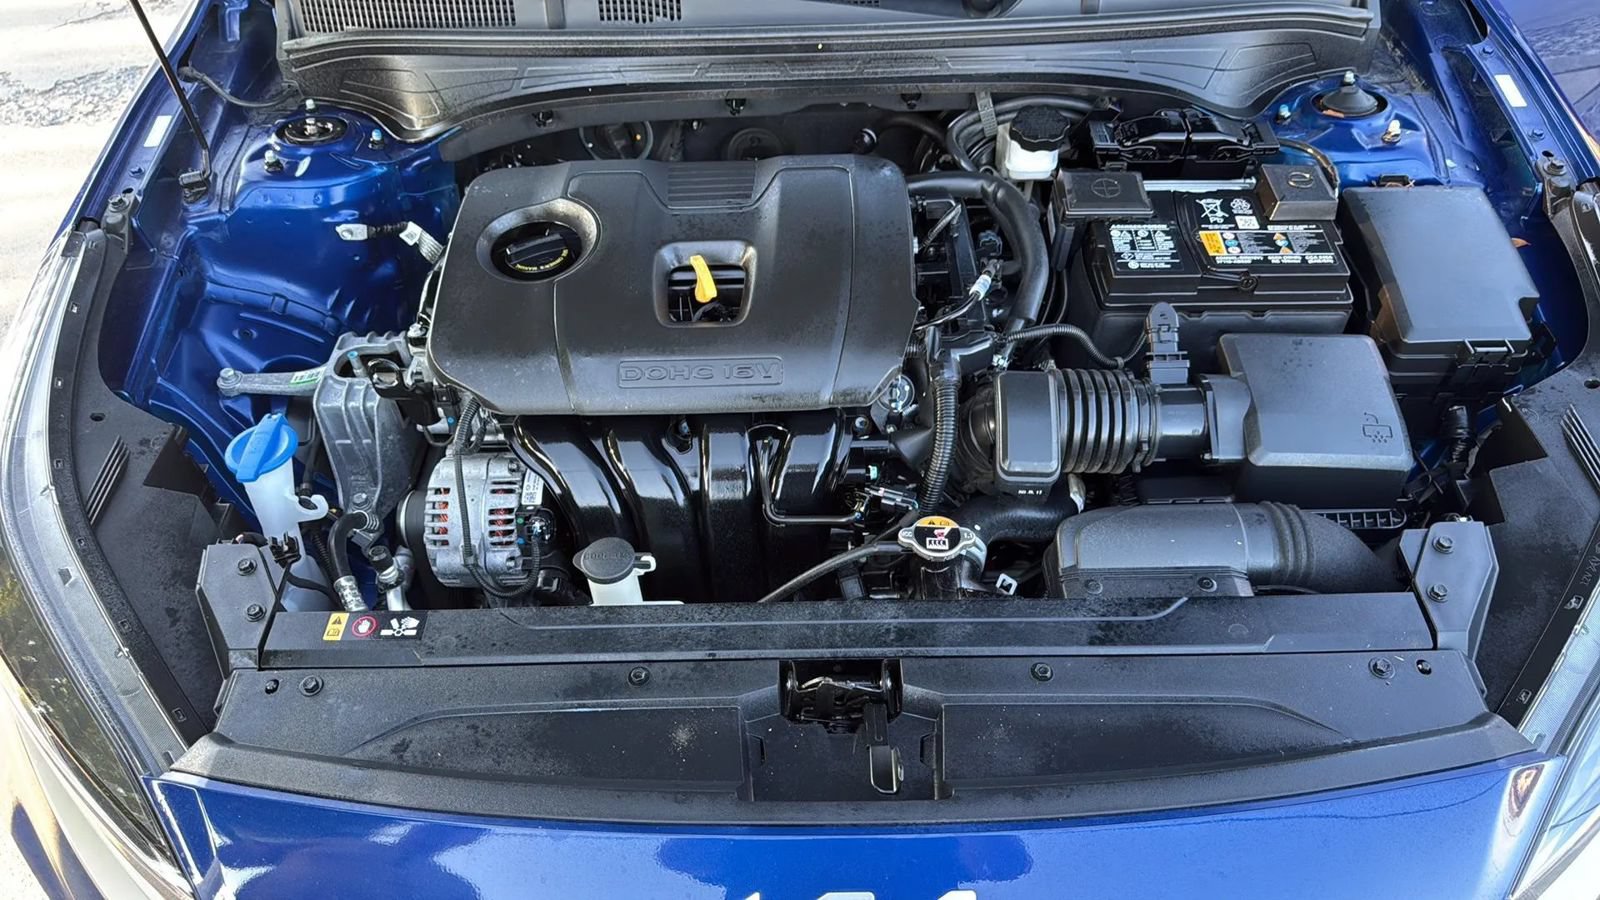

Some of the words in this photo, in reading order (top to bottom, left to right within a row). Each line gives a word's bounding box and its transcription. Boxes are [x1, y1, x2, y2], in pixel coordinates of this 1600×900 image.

[1209, 216, 1225, 224] Pb
[621, 364, 714, 382] DOHC
[723, 362, 779, 380] 16V
